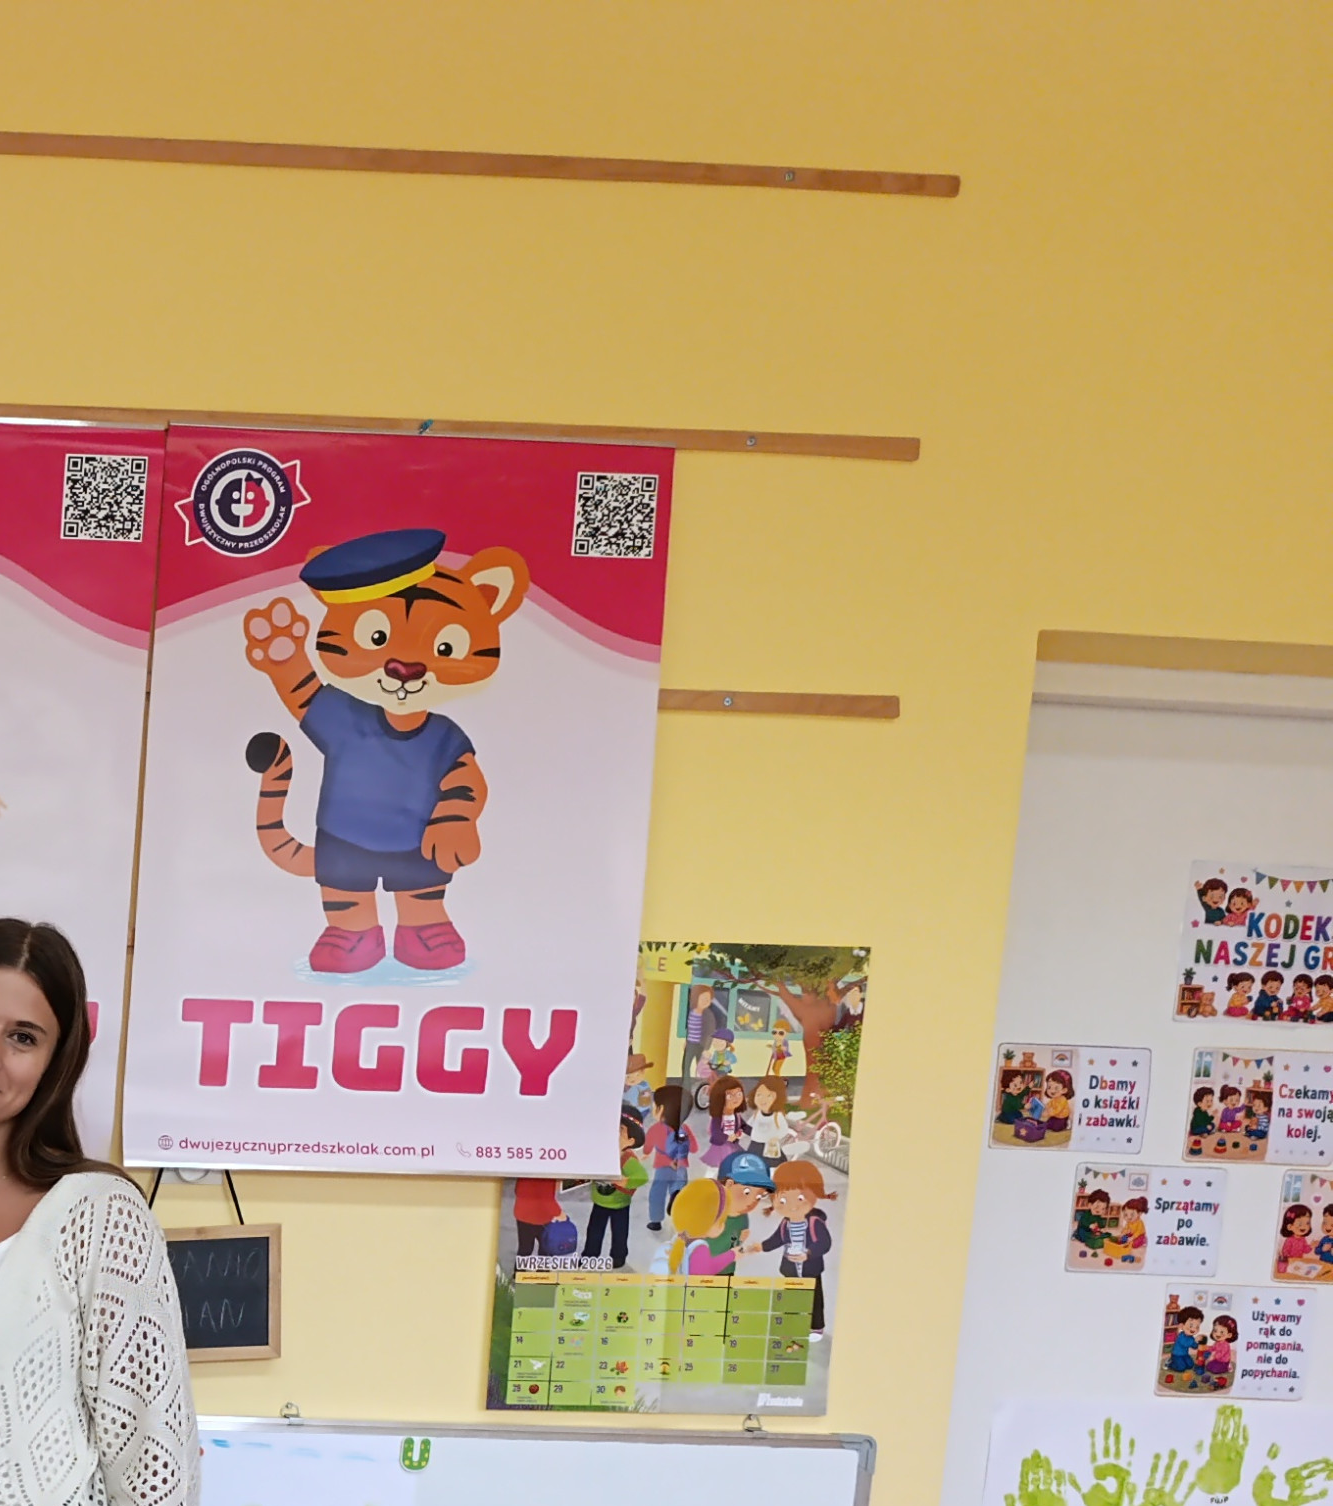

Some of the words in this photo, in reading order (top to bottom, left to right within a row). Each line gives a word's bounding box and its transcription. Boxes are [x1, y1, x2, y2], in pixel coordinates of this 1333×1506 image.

[201, 457, 256, 491] OGÓLNOPOLSKI
[257, 460, 286, 494] PROGRAM
[238, 506, 287, 549] PRZEDSZKOLAK
[1246, 912, 1333, 942] KODEK
[1194, 939, 1296, 970] NASZEJ
[181, 998, 579, 1097] TIGGY
[1088, 1075, 1136, 1095] Dbamy
[1081, 1098, 1090, 1109] o
[1278, 1105, 1293, 1119] na
[1078, 1112, 1082, 1127] i
[1085, 1113, 1141, 1129] zabawki.
[1286, 1124, 1322, 1141] kolej.
[178, 1137, 435, 1159] dwujezycznyprzedszkolak.com.pl
[475, 1145, 503, 1160] 883
[507, 1146, 534, 1161] 585
[539, 1147, 568, 1162] 200
[1154, 1197, 1220, 1215] Sprzątamy
[1176, 1217, 1193, 1231] po
[1155, 1233, 1210, 1247] zabawie.
[516, 1252, 580, 1270] WRZESIEŃ
[581, 1257, 613, 1270] 2026
[1251, 1310, 1302, 1325] Używamy
[1259, 1325, 1276, 1339] rąk
[1279, 1326, 1292, 1337] do
[1246, 1340, 1304, 1354] pomagania,
[1256, 1353, 1272, 1365] nie
[1274, 1354, 1288, 1365] do
[1241, 1367, 1300, 1380] popychania.
